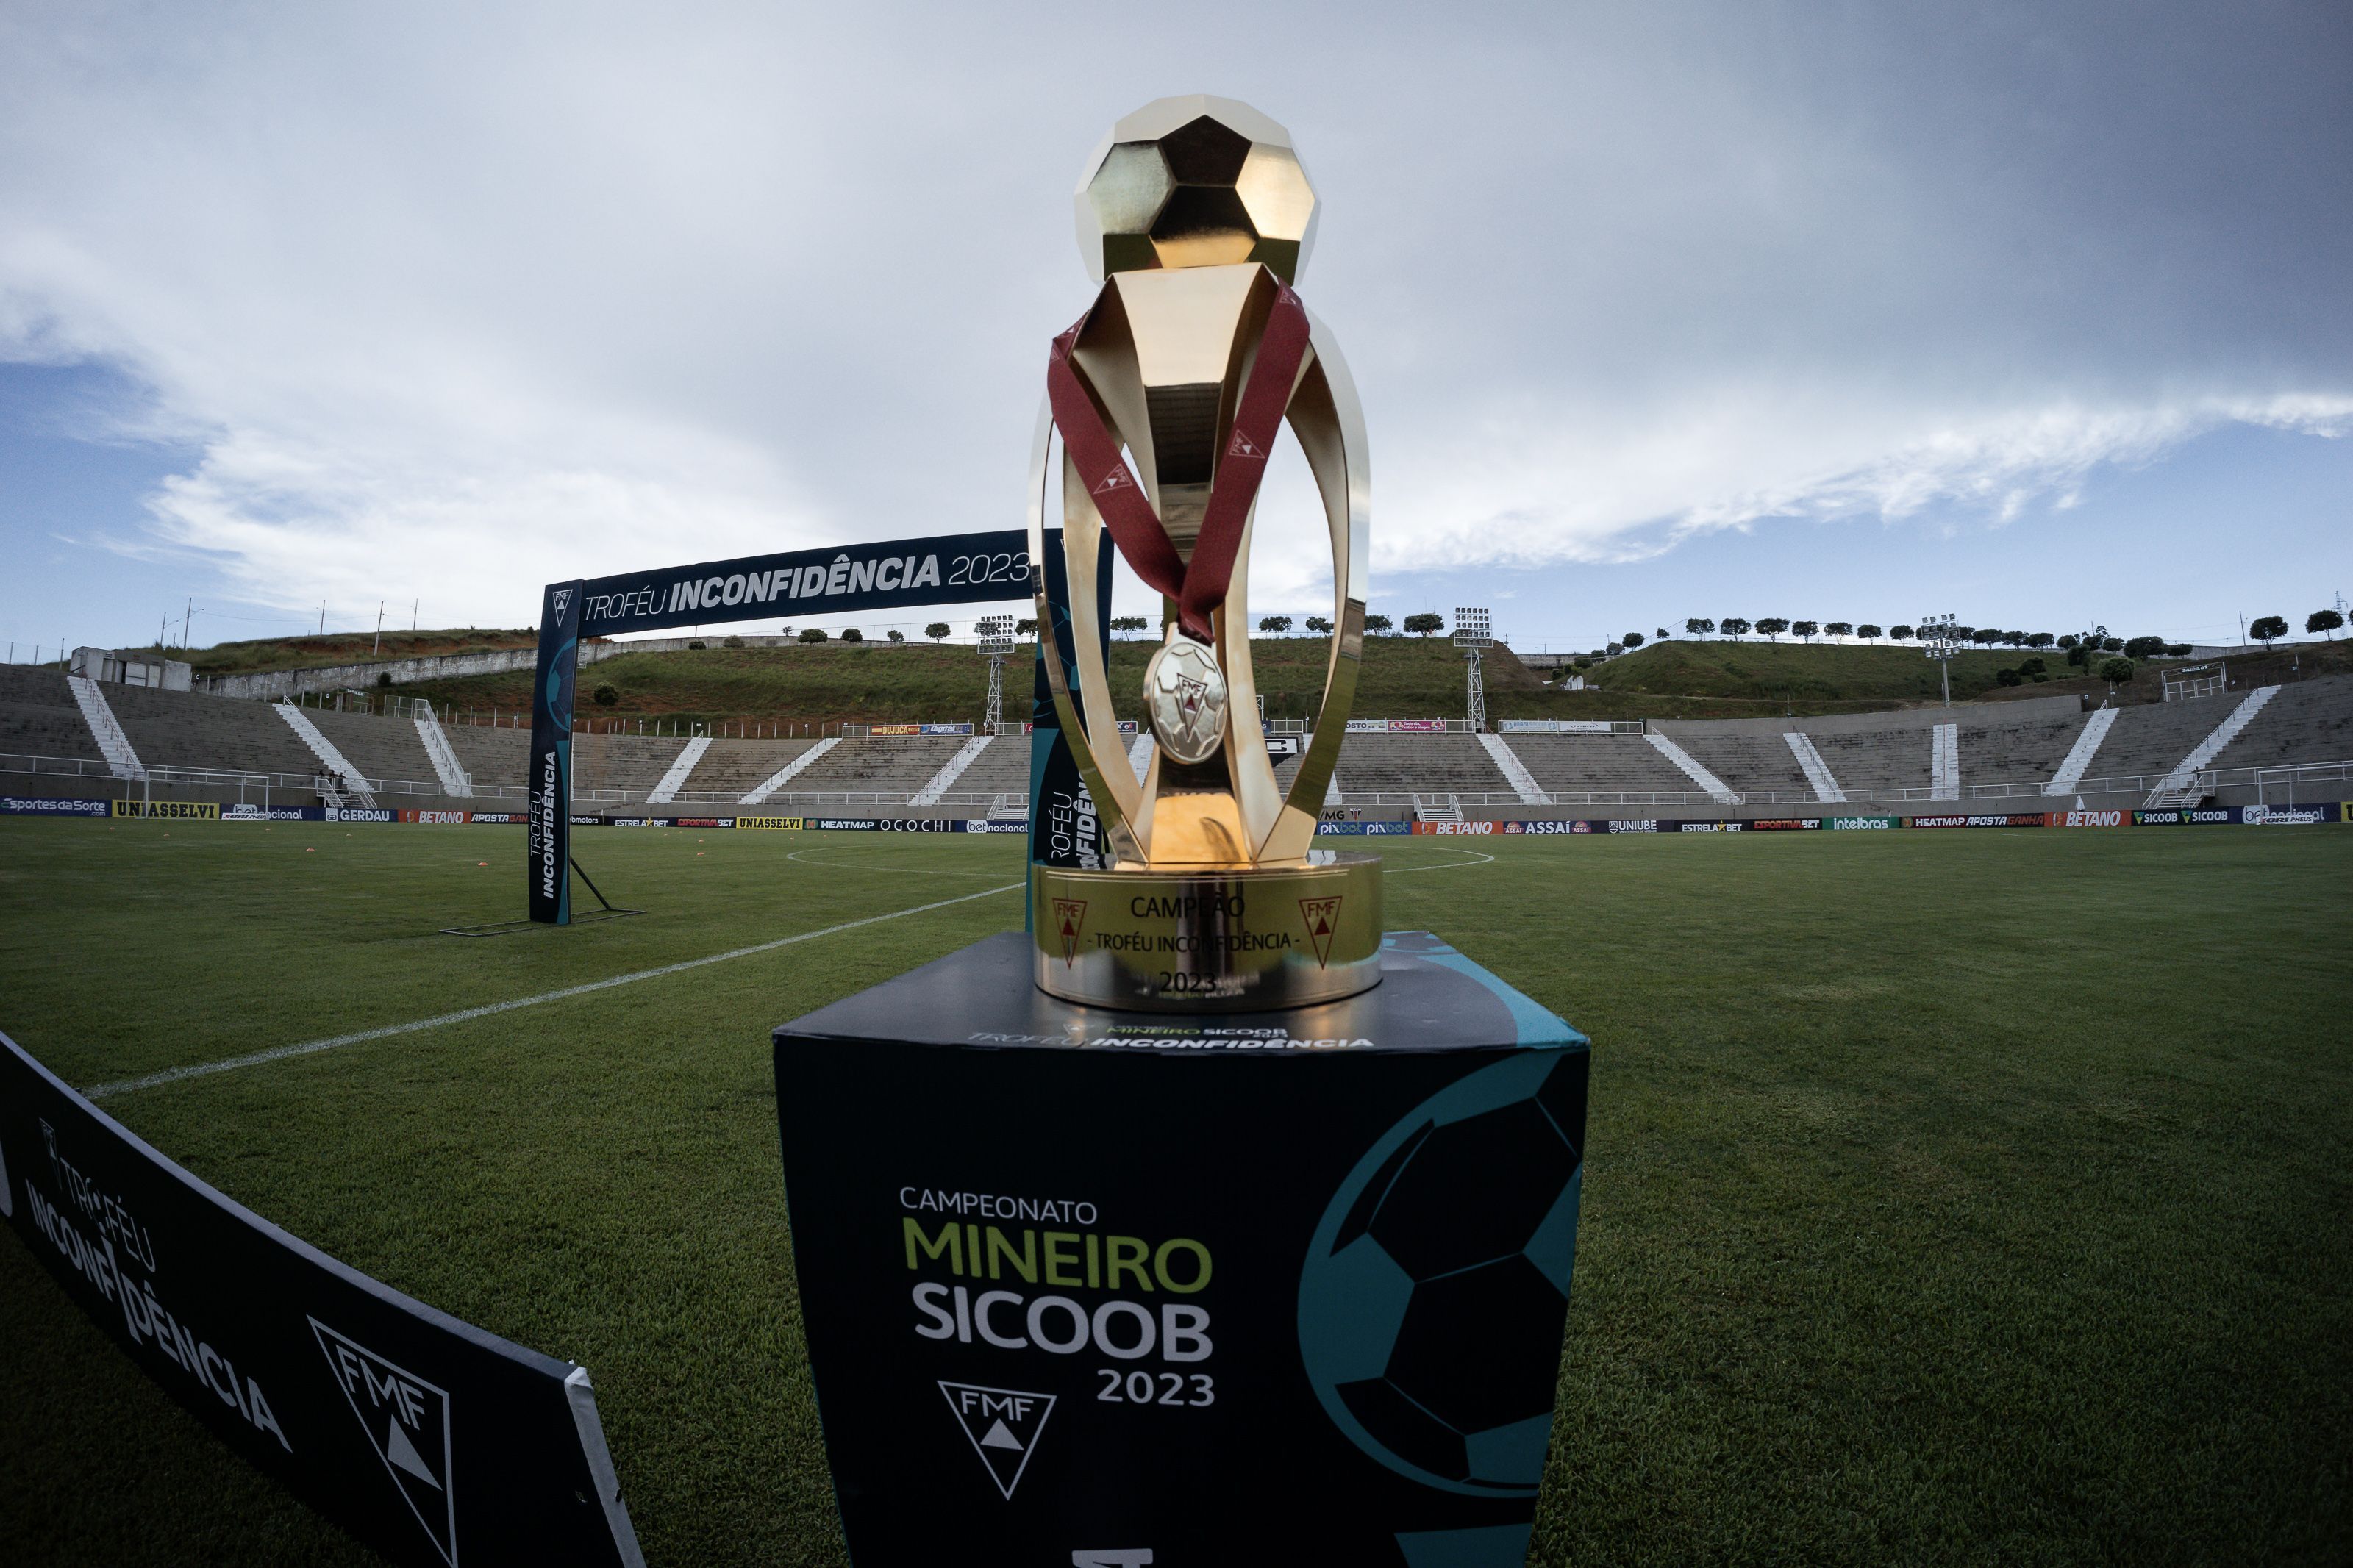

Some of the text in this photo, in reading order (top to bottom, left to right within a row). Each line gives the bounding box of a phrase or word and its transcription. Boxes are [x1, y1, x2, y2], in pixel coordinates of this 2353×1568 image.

[586, 552, 1031, 620] TROFÉU INCONFIDÊNCIA 2023
[555, 593, 569, 601] FMF
[340, 809, 390, 821] GERDAU
[418, 811, 464, 823] BETANO
[571, 816, 599, 824] bmotors
[1915, 817, 1965, 826] HEATMAP
[2065, 811, 2121, 826] BETANO
[2144, 812, 2177, 823] SICOOB
[2192, 809, 2228, 822] SICOOB
[530, 791, 542, 857] TROFÉU
[543, 751, 556, 899] INCONFIDÊNCIA
[740, 818, 801, 828] UNIASSELVI
[821, 820, 874, 829] HEATMAP
[880, 820, 951, 831] OGOCHI
[1048, 792, 1072, 859] ROFÉU
[1436, 822, 1493, 834] BETANO
[1618, 820, 1657, 830] UNIUBE
[1833, 817, 1888, 830] intelbras
[1308, 901, 1335, 917] FMF
[1096, 931, 1152, 951] TROFÉU
[1160, 972, 1216, 993] 2023
[1091, 1038, 1374, 1048] INCONFIDÊNCIA
[899, 1186, 1097, 1225] CAMPEONATO
[59, 1157, 156, 1275] TROFÉU
[903, 1217, 1213, 1294] MINEIRO
[25, 1178, 293, 1455] INCONFIDÊNCIA
[912, 1281, 1213, 1362] SICOOB
[335, 1344, 425, 1431] FMF
[1097, 1369, 1215, 1406] 2023
[960, 1390, 1035, 1422] FMF
